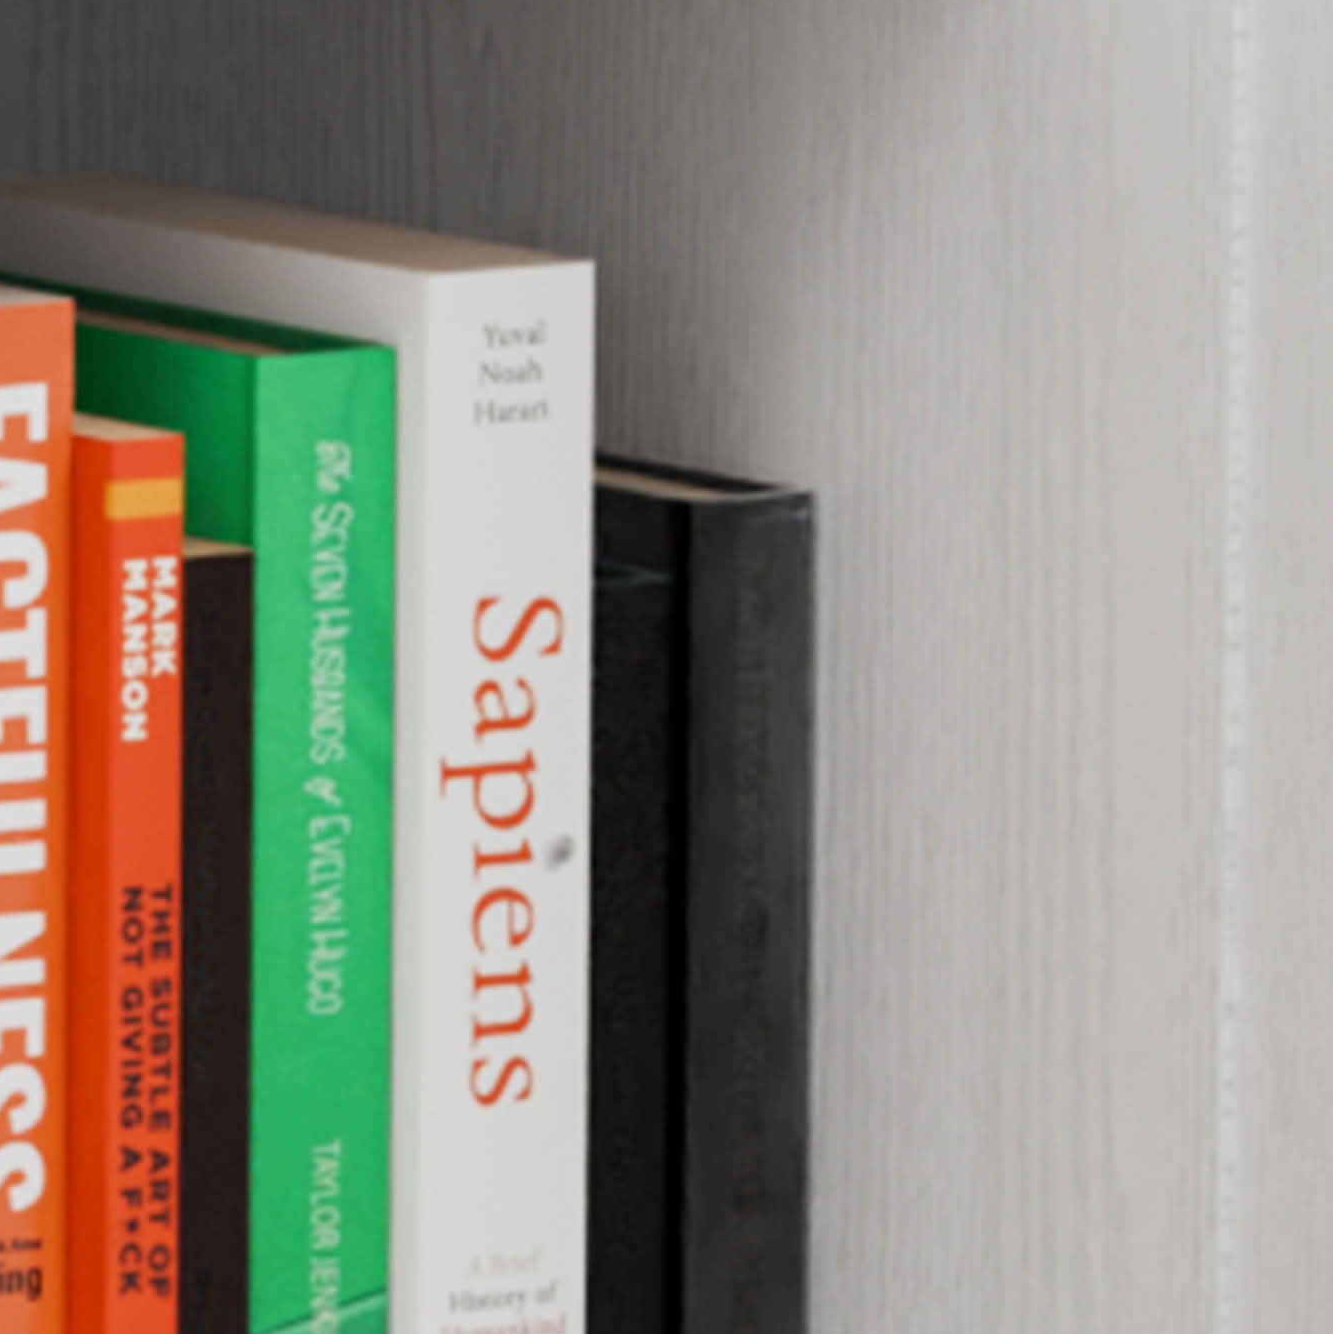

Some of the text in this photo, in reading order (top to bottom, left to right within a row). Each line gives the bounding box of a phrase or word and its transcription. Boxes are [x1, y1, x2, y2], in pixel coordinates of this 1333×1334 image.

[121, 558, 149, 744] MANSON
[151, 554, 178, 678] MARK
[440, 593, 566, 1108] Sapiens
[122, 885, 144, 980] NOT
[120, 987, 145, 1132] GIVING
[149, 882, 173, 1300] THE SUBTLE ART OF
[120, 1144, 143, 1171] A
[309, 1139, 342, 1249] TAYLOR
